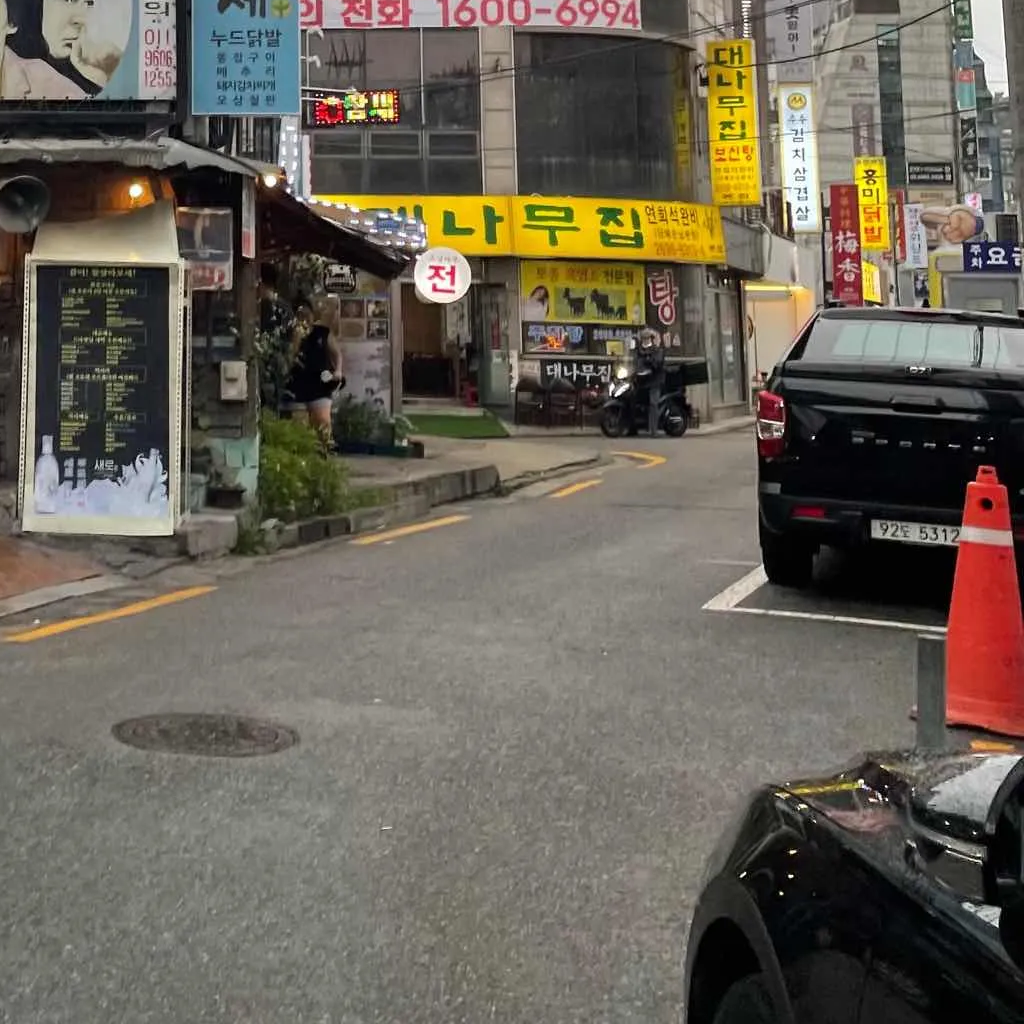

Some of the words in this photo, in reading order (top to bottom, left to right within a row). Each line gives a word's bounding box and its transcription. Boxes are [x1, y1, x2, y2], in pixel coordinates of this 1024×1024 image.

[209, 29, 283, 48] 누드닭발
[714, 45, 747, 141] 대나무집
[428, 265, 455, 294] 전
[647, 268, 679, 325] 탕
[546, 362, 612, 383] 대나무집
